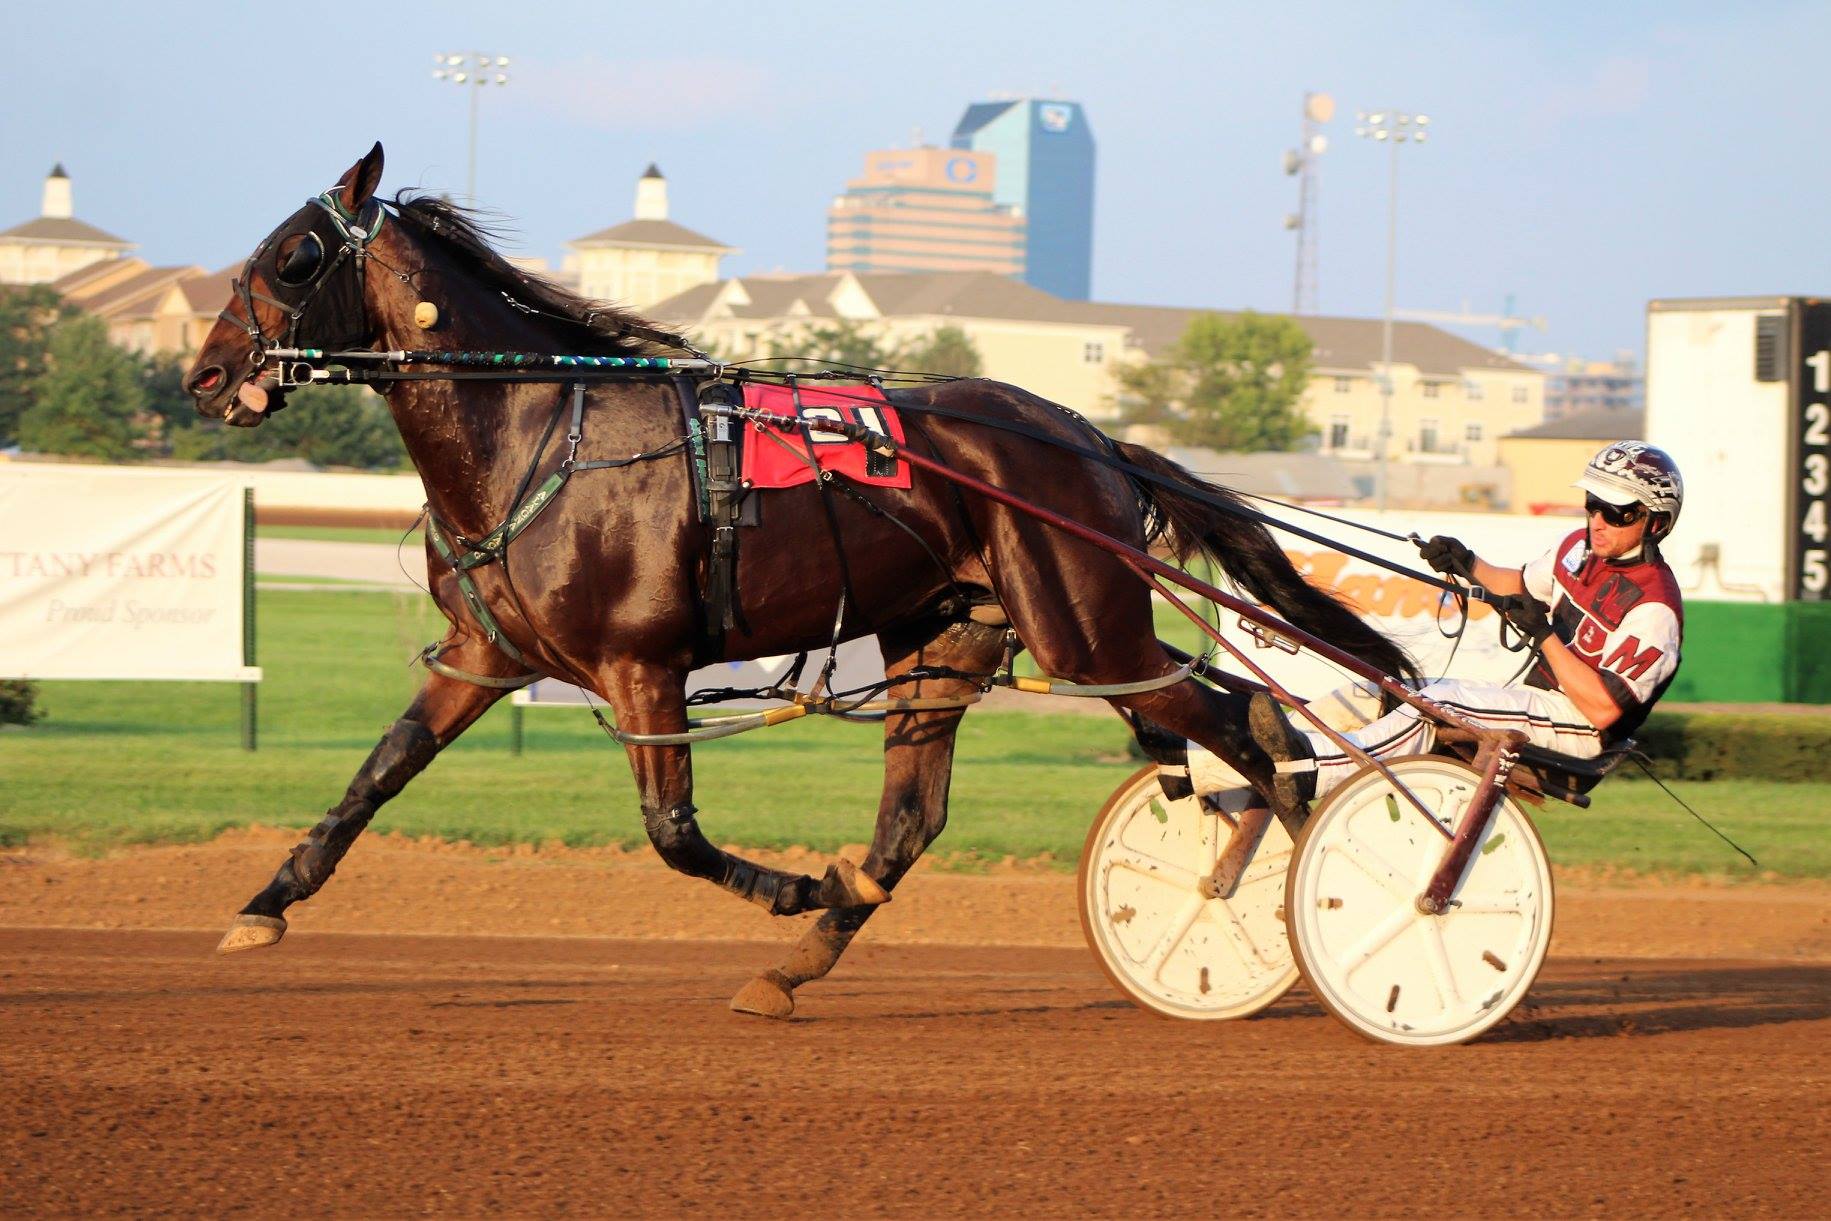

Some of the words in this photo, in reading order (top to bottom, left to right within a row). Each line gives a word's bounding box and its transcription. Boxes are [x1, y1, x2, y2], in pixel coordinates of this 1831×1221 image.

[1805, 350, 1830, 393] 1
[1804, 402, 1830, 446] 2
[1802, 453, 1828, 496] 3
[1802, 500, 1828, 543] 4
[0, 551, 102, 578] TANY
[104, 551, 218, 579] FARMS
[1802, 549, 1828, 593] 5
[47, 598, 116, 623] Proud
[121, 600, 217, 630] Sponsor
[1603, 634, 1664, 682] M
